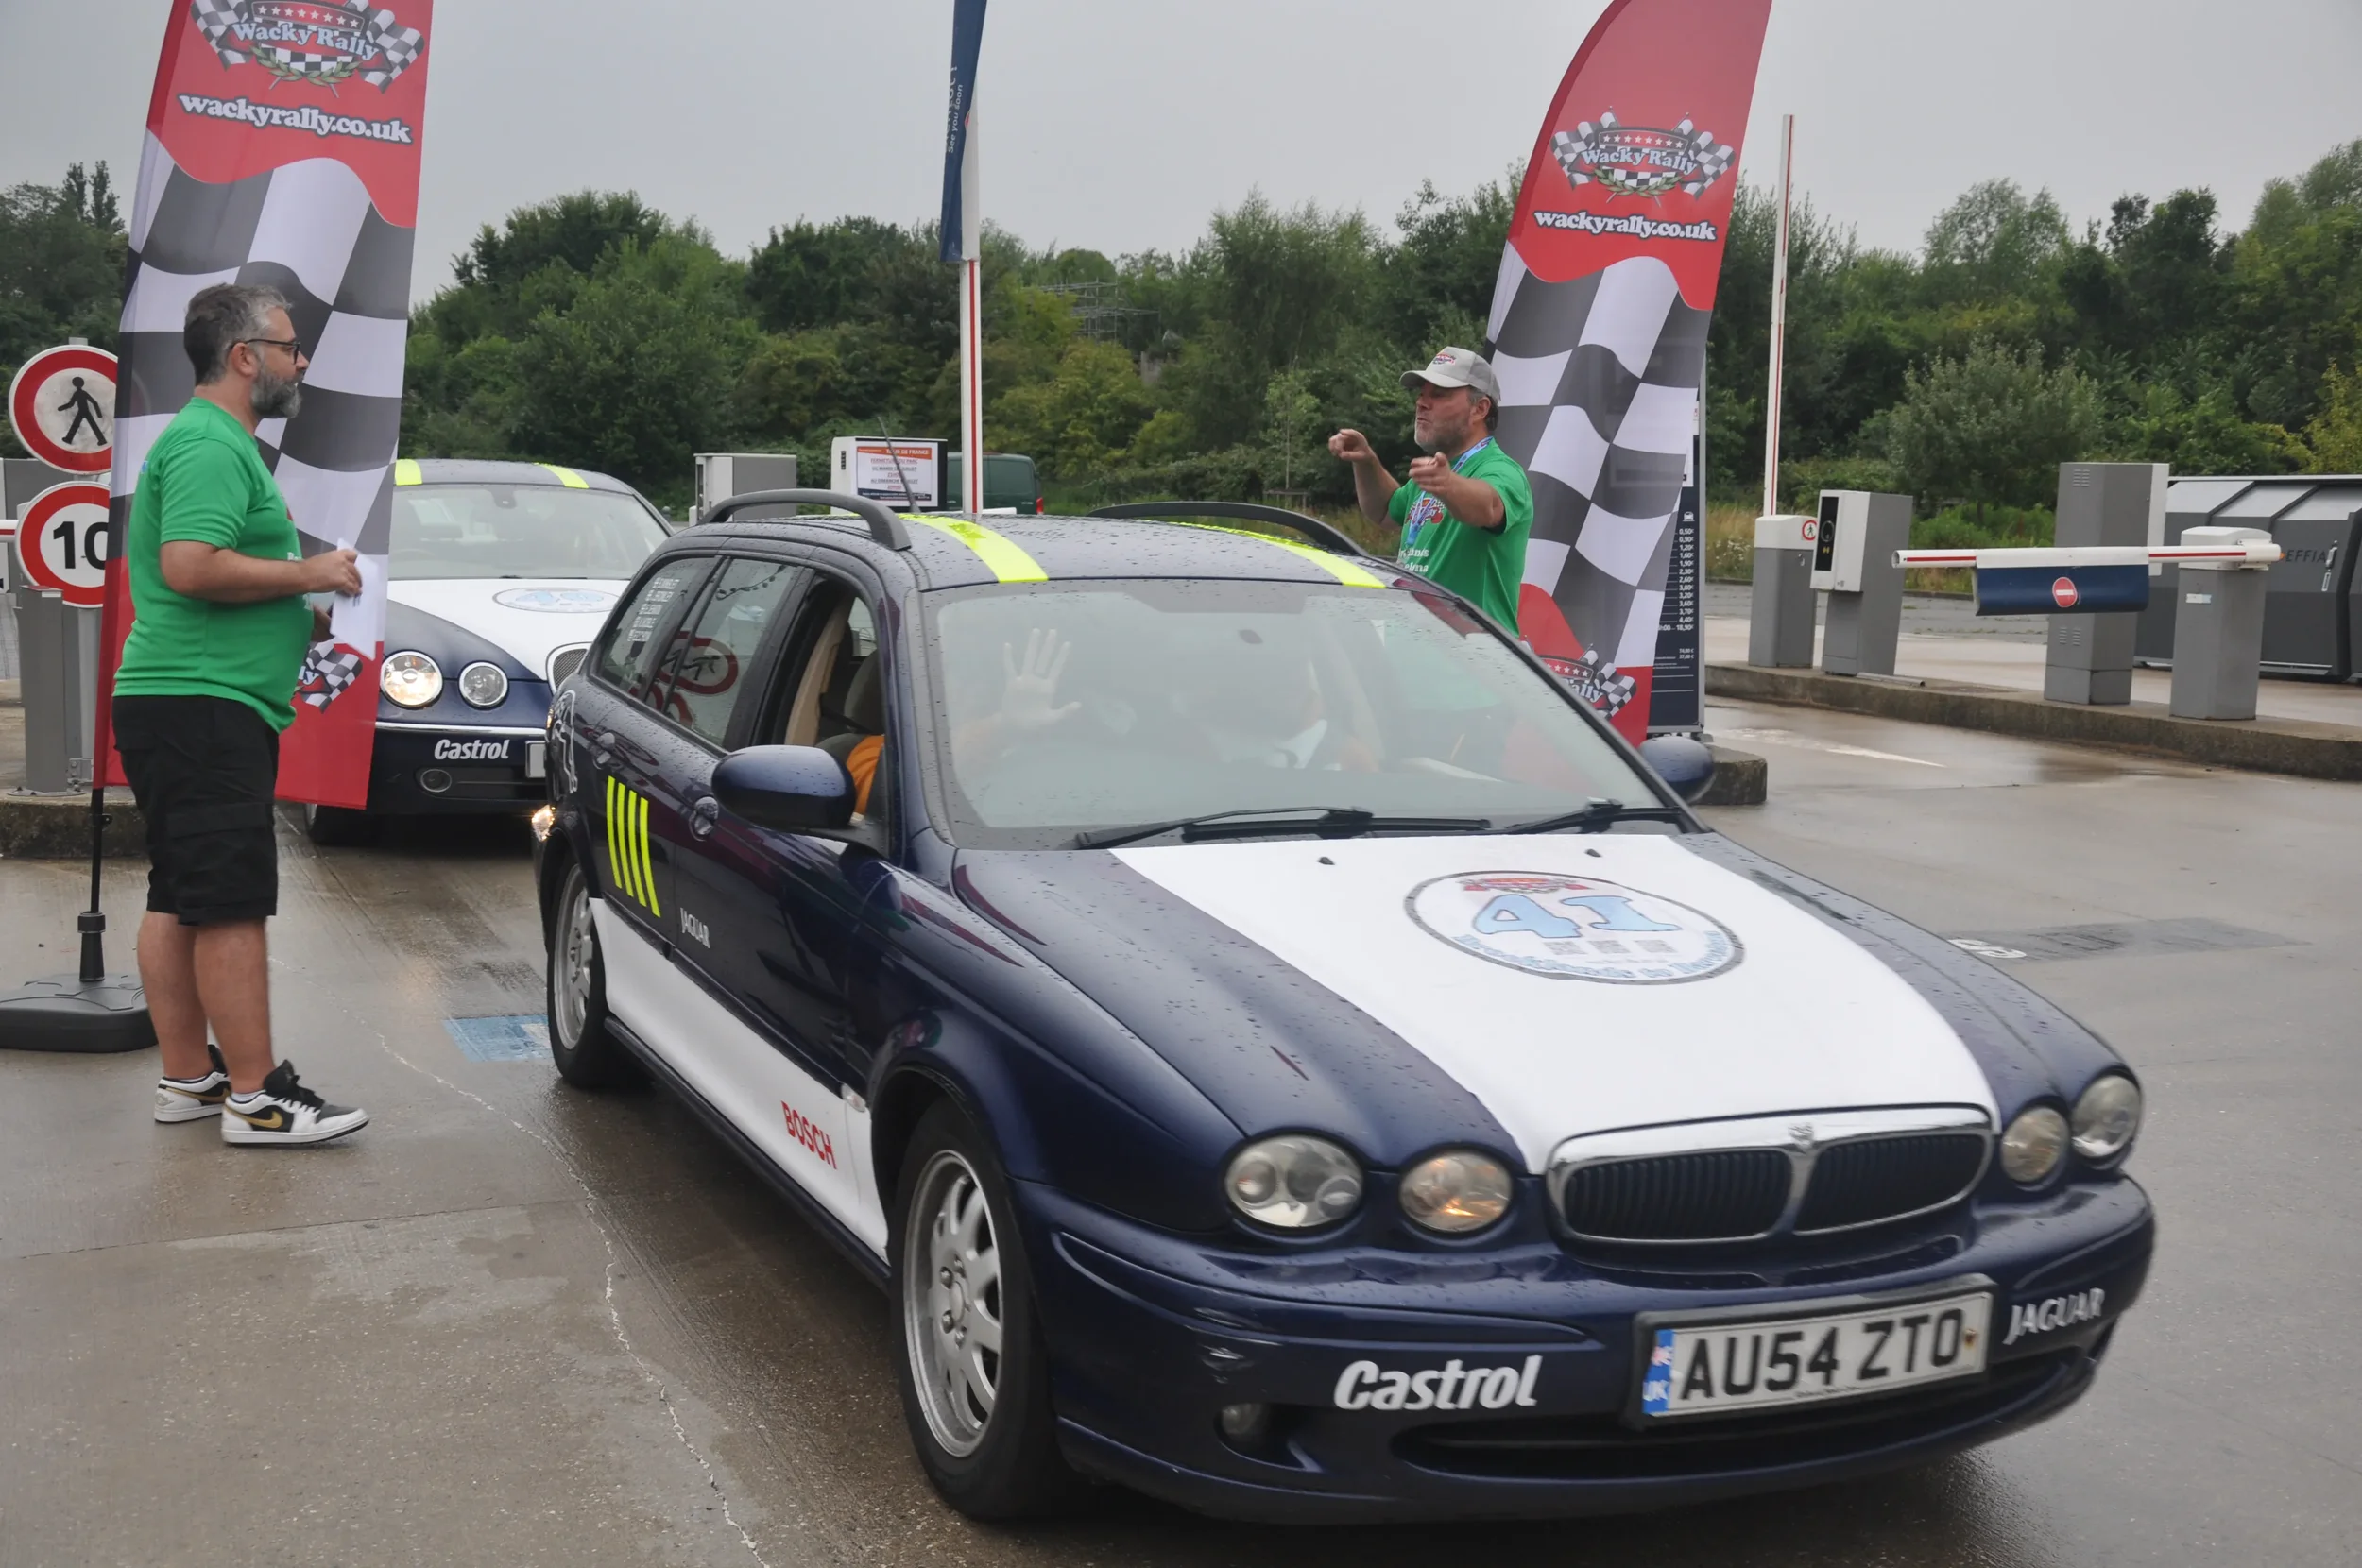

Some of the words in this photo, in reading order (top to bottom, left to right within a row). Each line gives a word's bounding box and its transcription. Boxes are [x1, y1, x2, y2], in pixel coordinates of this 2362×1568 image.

[232, 21, 313, 45] Wacky
[316, 27, 379, 61] Rally
[178, 94, 413, 143] wackyrally.co.uk
[955, 84, 964, 110] soon
[1582, 147, 1648, 166] Wacky
[1649, 150, 1698, 175] Rally
[1533, 211, 1717, 240] wackyrally.co.uk
[53, 521, 107, 570] 10
[2285, 549, 2327, 562] EFFIA
[435, 739, 509, 760] Castrol
[680, 907, 710, 949] JAGUAR
[1471, 893, 1684, 939] 41
[780, 1100, 837, 1169] BOSCH
[2002, 1287, 2105, 1345] JAGUAR
[1679, 1326, 1840, 1400] AU54
[1857, 1307, 1964, 1381] ZTO
[1333, 1355, 1544, 1410] Castrol
